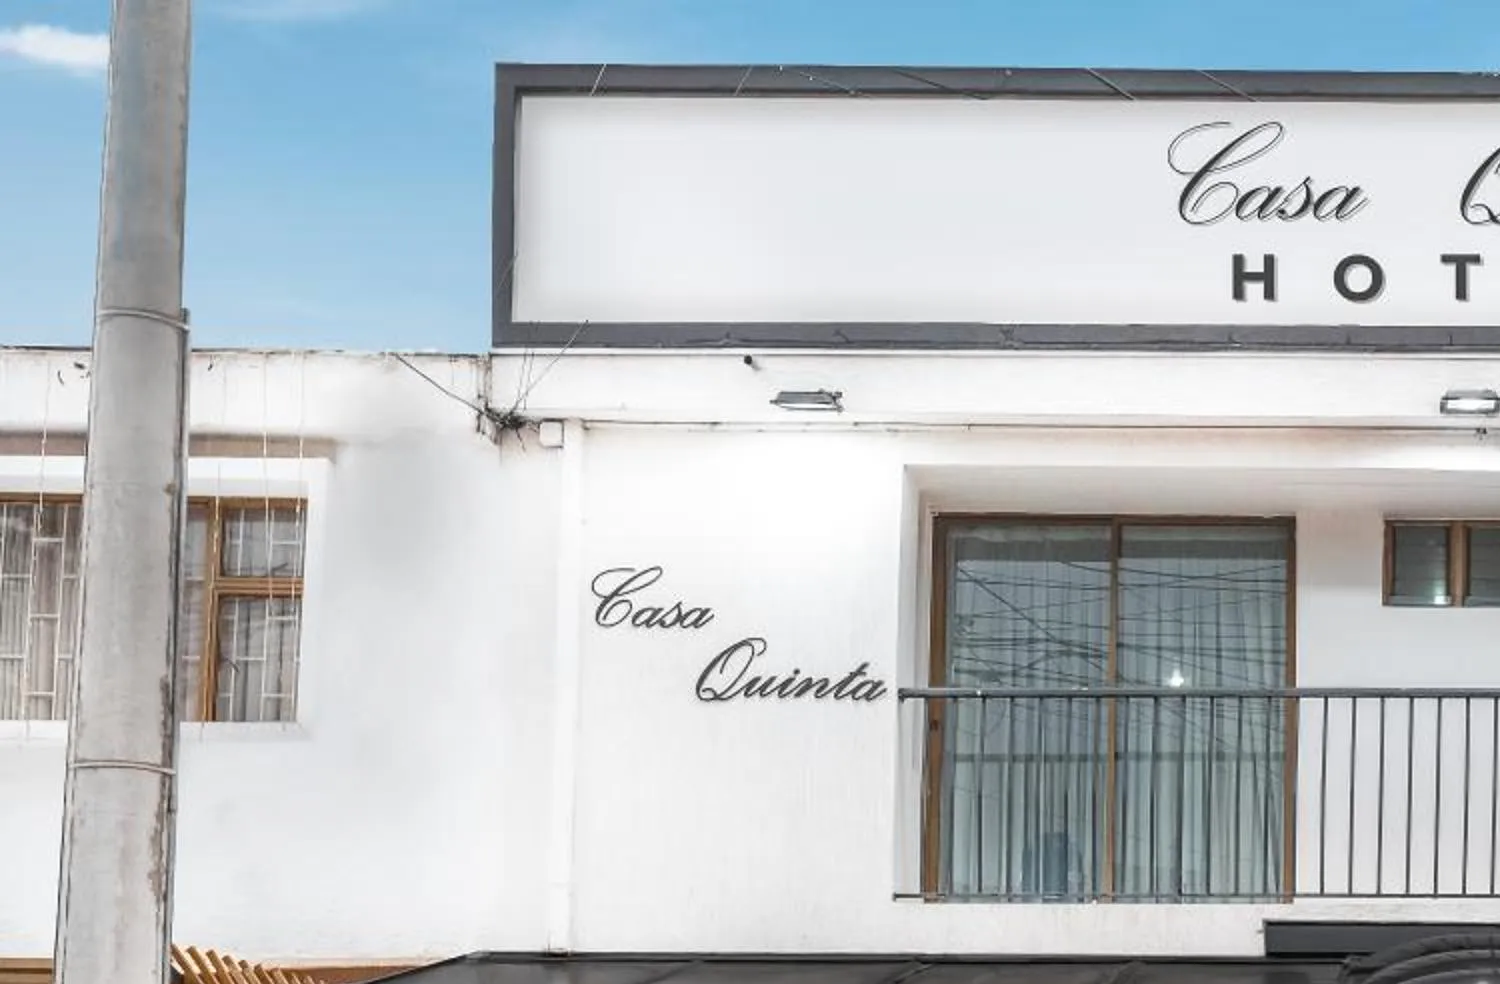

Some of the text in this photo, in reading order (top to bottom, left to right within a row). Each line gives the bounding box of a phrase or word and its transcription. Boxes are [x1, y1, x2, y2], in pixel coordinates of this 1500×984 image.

[1167, 120, 1369, 226] Casa
[591, 565, 715, 630] Casa
[695, 637, 888, 702] Quinta
